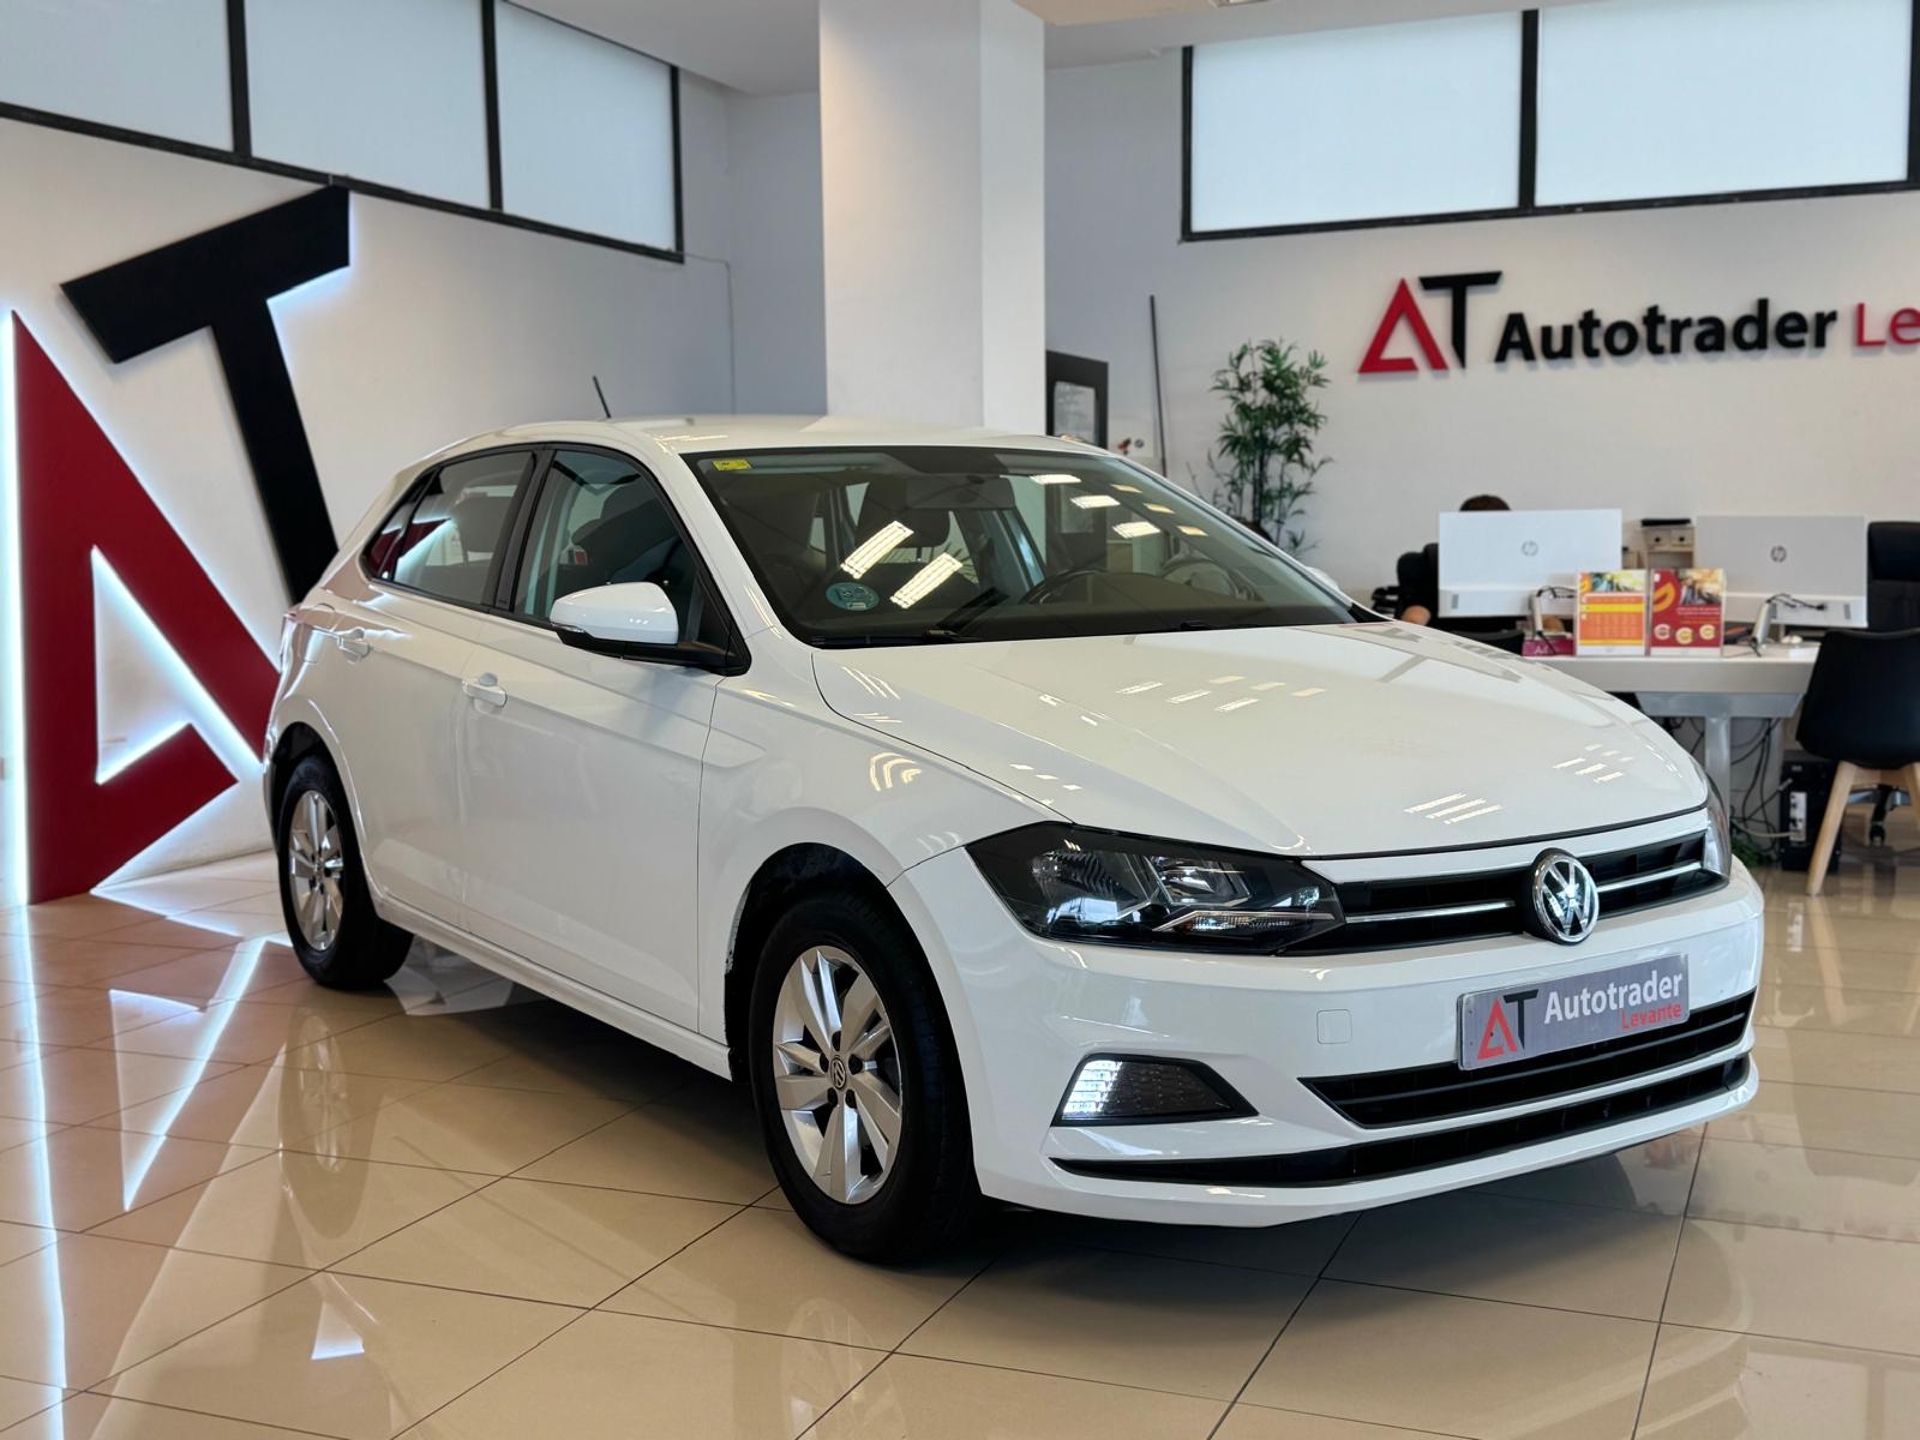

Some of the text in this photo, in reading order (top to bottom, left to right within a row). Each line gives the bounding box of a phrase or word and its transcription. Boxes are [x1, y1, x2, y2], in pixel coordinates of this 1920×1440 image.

[1358, 271, 1920, 373] AT Autotrader Le
[1478, 970, 1682, 1060] AT Autotrader
[1621, 1002, 1682, 1031] Levante
